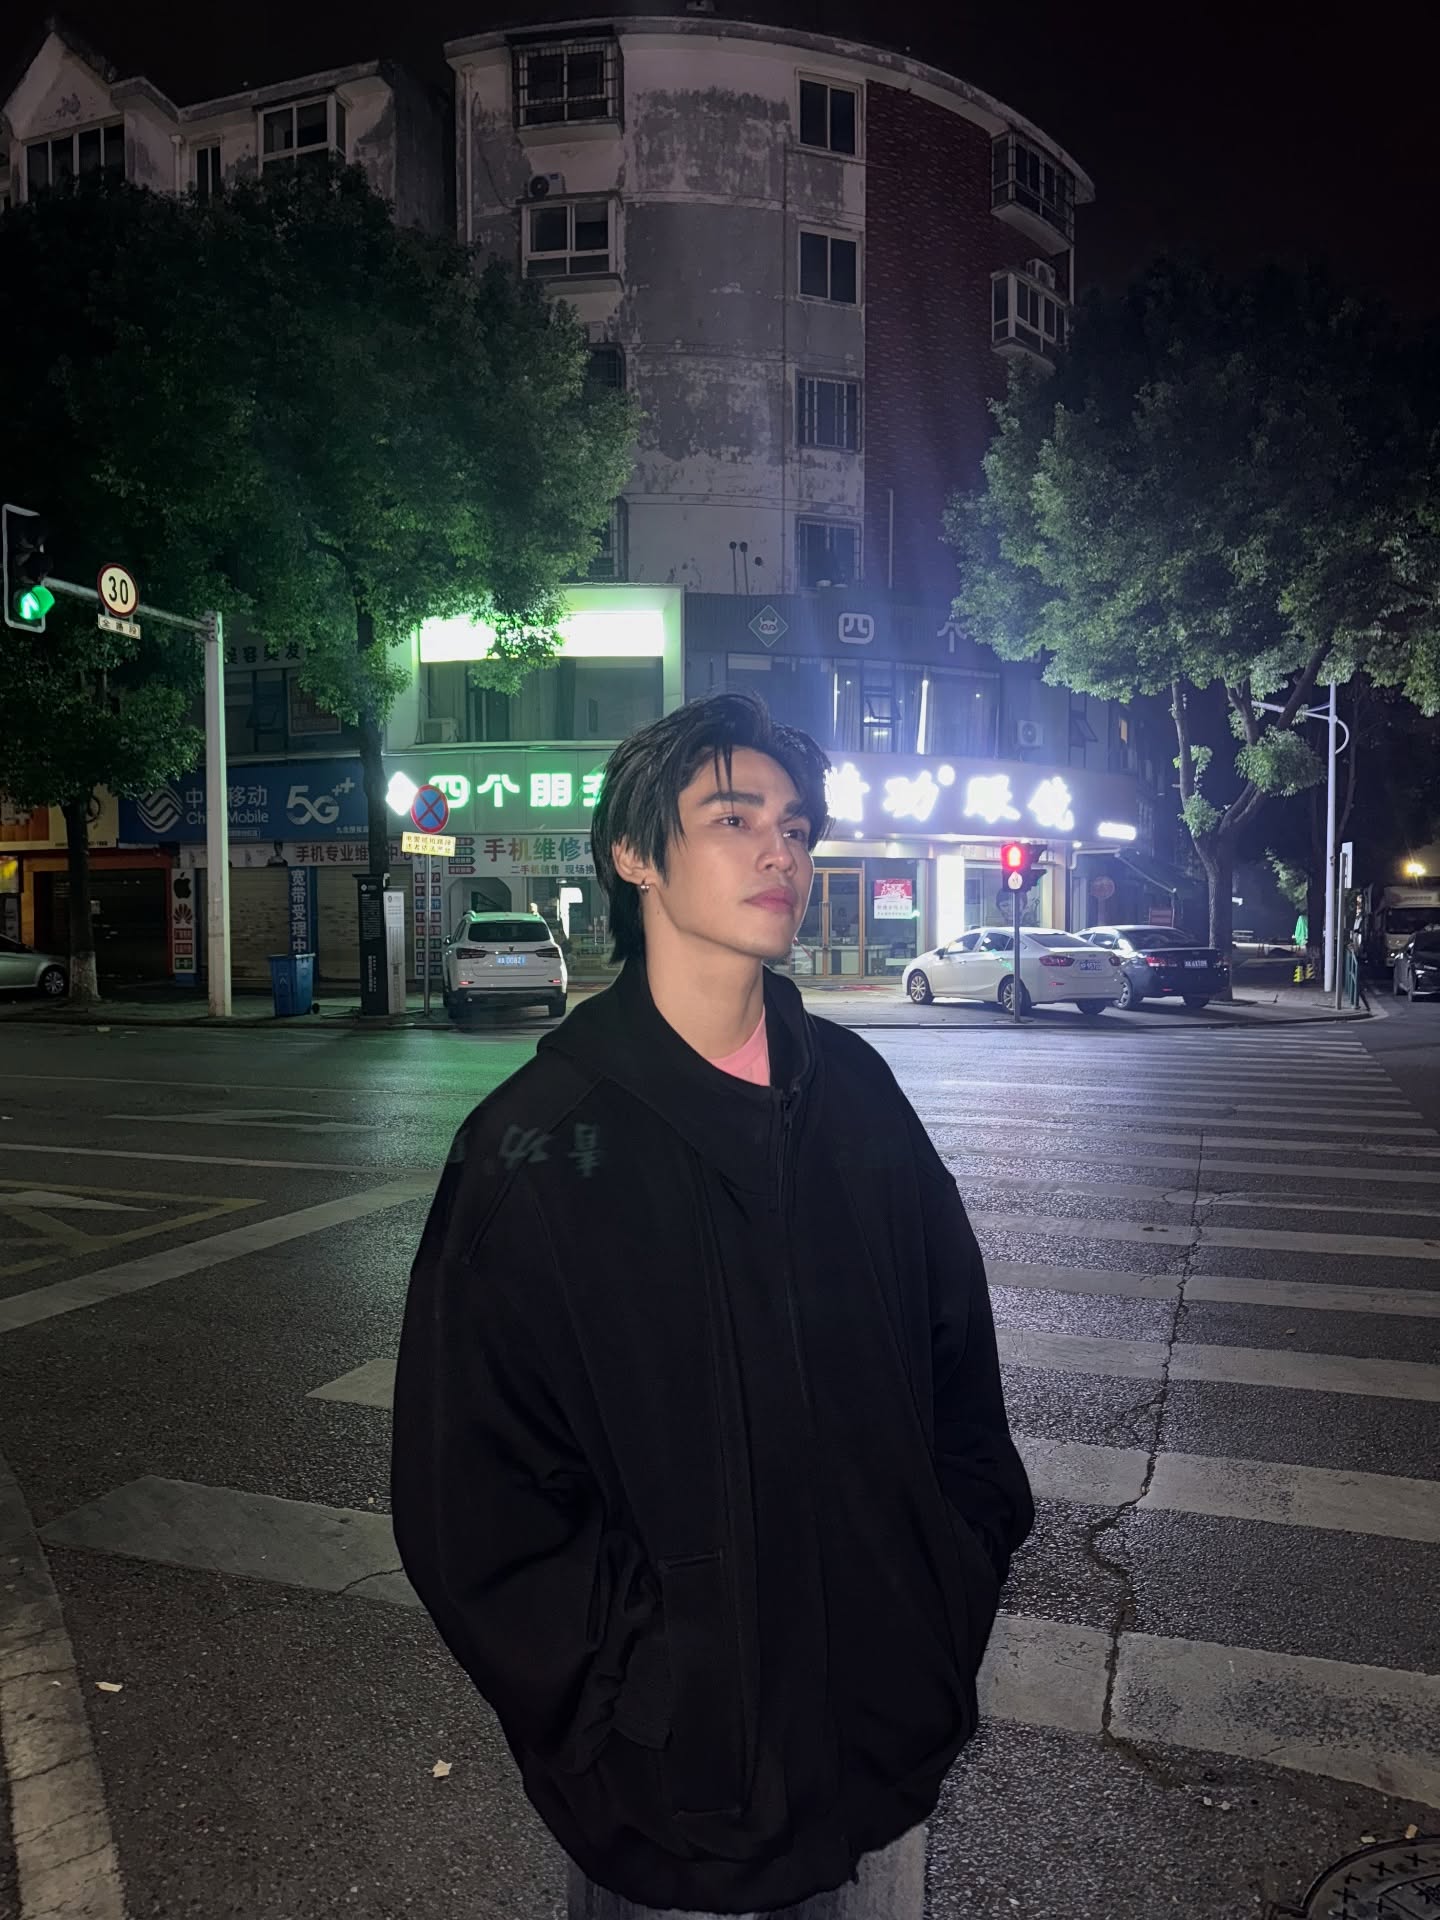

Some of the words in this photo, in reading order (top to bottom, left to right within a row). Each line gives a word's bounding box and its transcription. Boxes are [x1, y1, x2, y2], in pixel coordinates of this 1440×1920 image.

[108, 576, 129, 605] 30
[185, 784, 268, 809] 中移动
